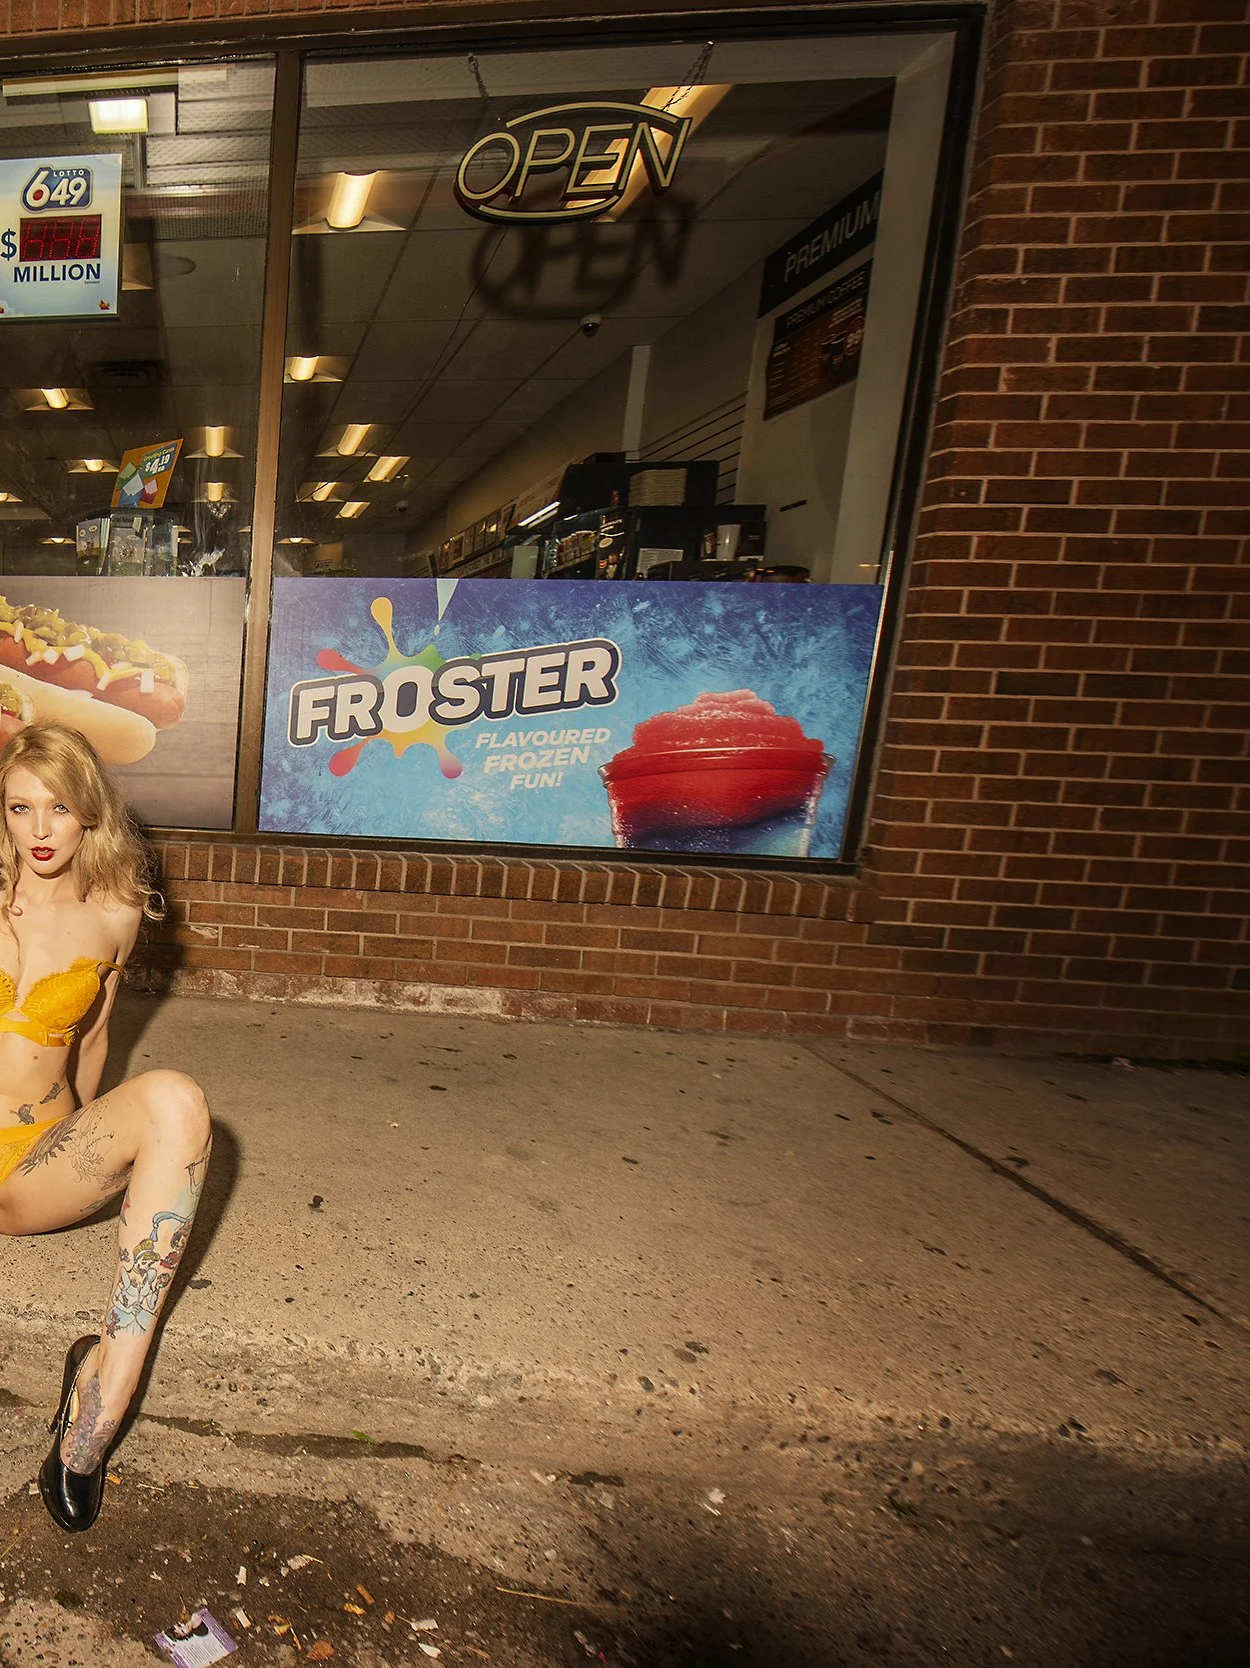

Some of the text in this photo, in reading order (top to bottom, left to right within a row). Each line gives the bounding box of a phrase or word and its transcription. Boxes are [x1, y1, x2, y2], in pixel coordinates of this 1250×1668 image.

[52, 169, 86, 177] LOTTO
[456, 117, 694, 201] OPEN
[25, 171, 88, 208] 649
[0, 228, 18, 261] $
[783, 190, 880, 284] PREMIUM
[13, 263, 101, 283] MILLION
[290, 642, 622, 745] FROSTER
[476, 727, 612, 749] FLAVOURED
[483, 747, 591, 774] FROZEN
[510, 773, 563, 790] FUN!
